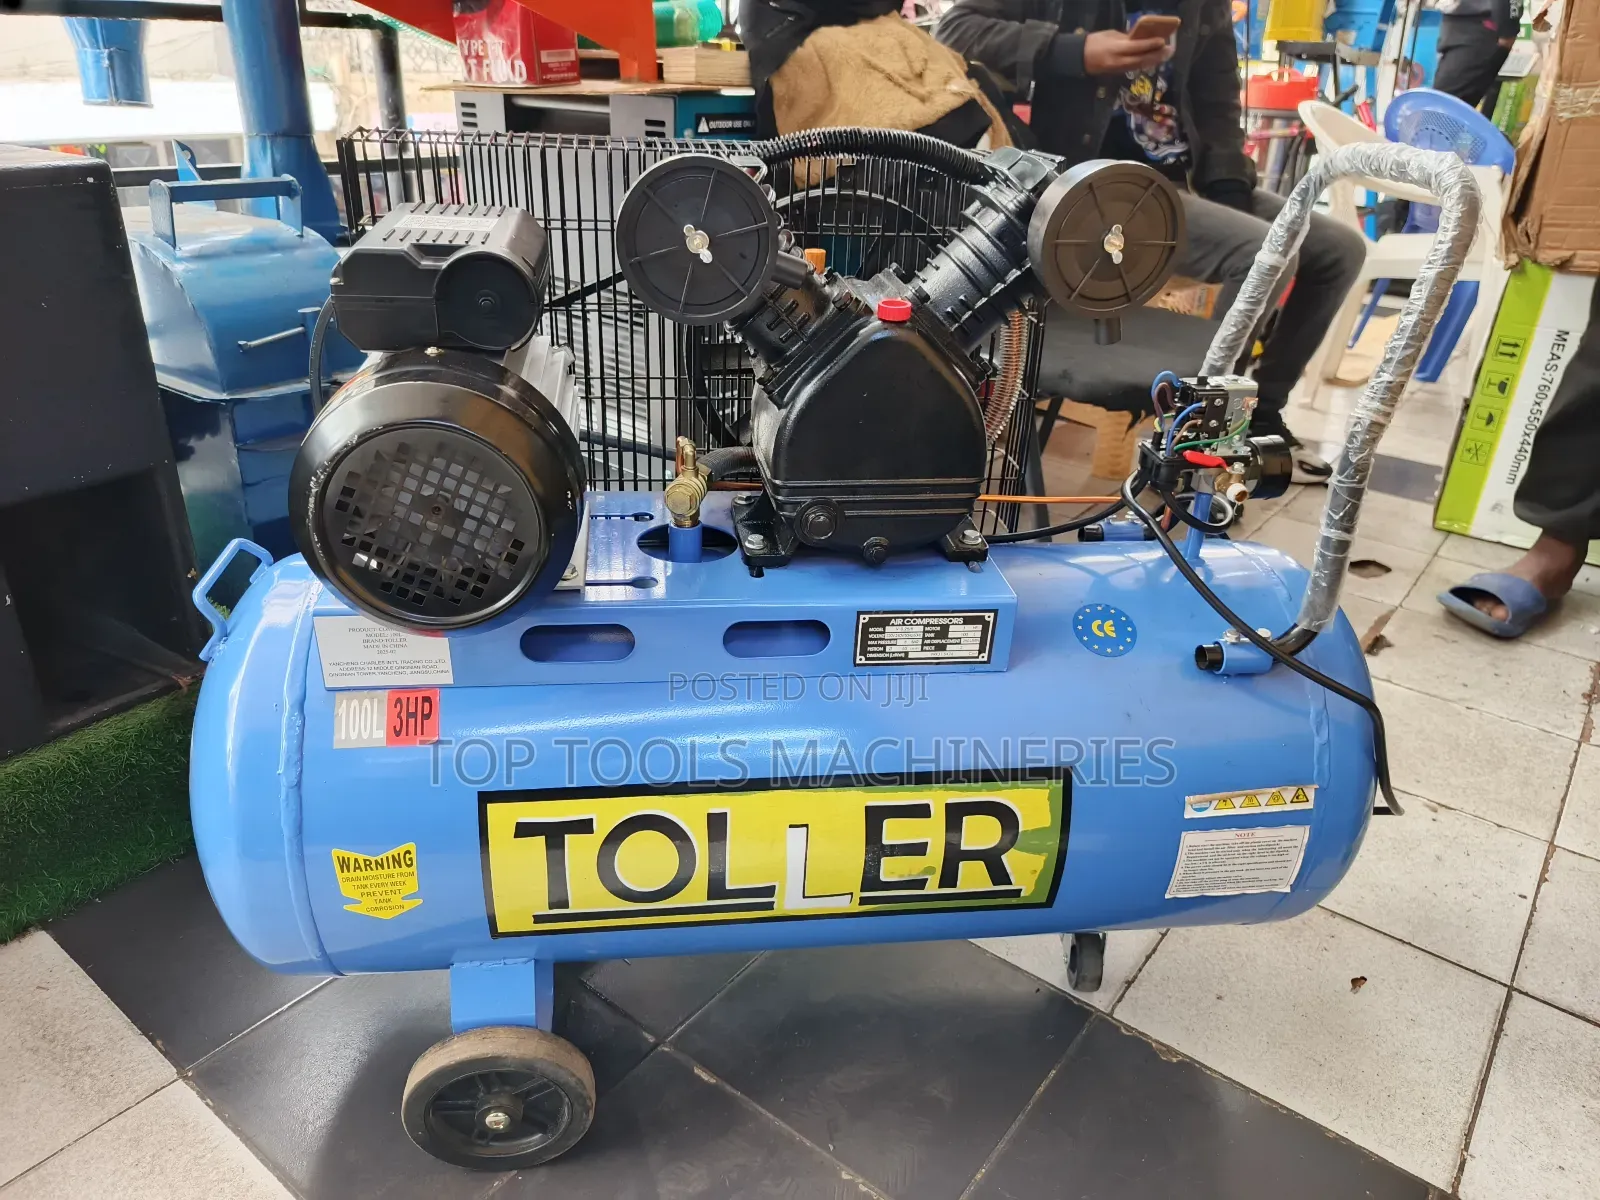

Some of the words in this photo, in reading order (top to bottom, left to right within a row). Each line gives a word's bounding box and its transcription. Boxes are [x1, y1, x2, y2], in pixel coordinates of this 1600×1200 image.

[709, 120, 732, 129] OUTDOOR
[733, 120, 742, 128] USE
[889, 618, 903, 626] AIR
[904, 617, 964, 626] COMPRESSORS
[338, 698, 384, 739] 100L
[393, 696, 433, 737] 3HP
[513, 797, 1023, 910] TOLLER
[337, 850, 414, 874] WARNING
[363, 872, 396, 881] MOISTURE
[360, 888, 402, 898] PREVENT
[365, 904, 405, 912] CORROSION
